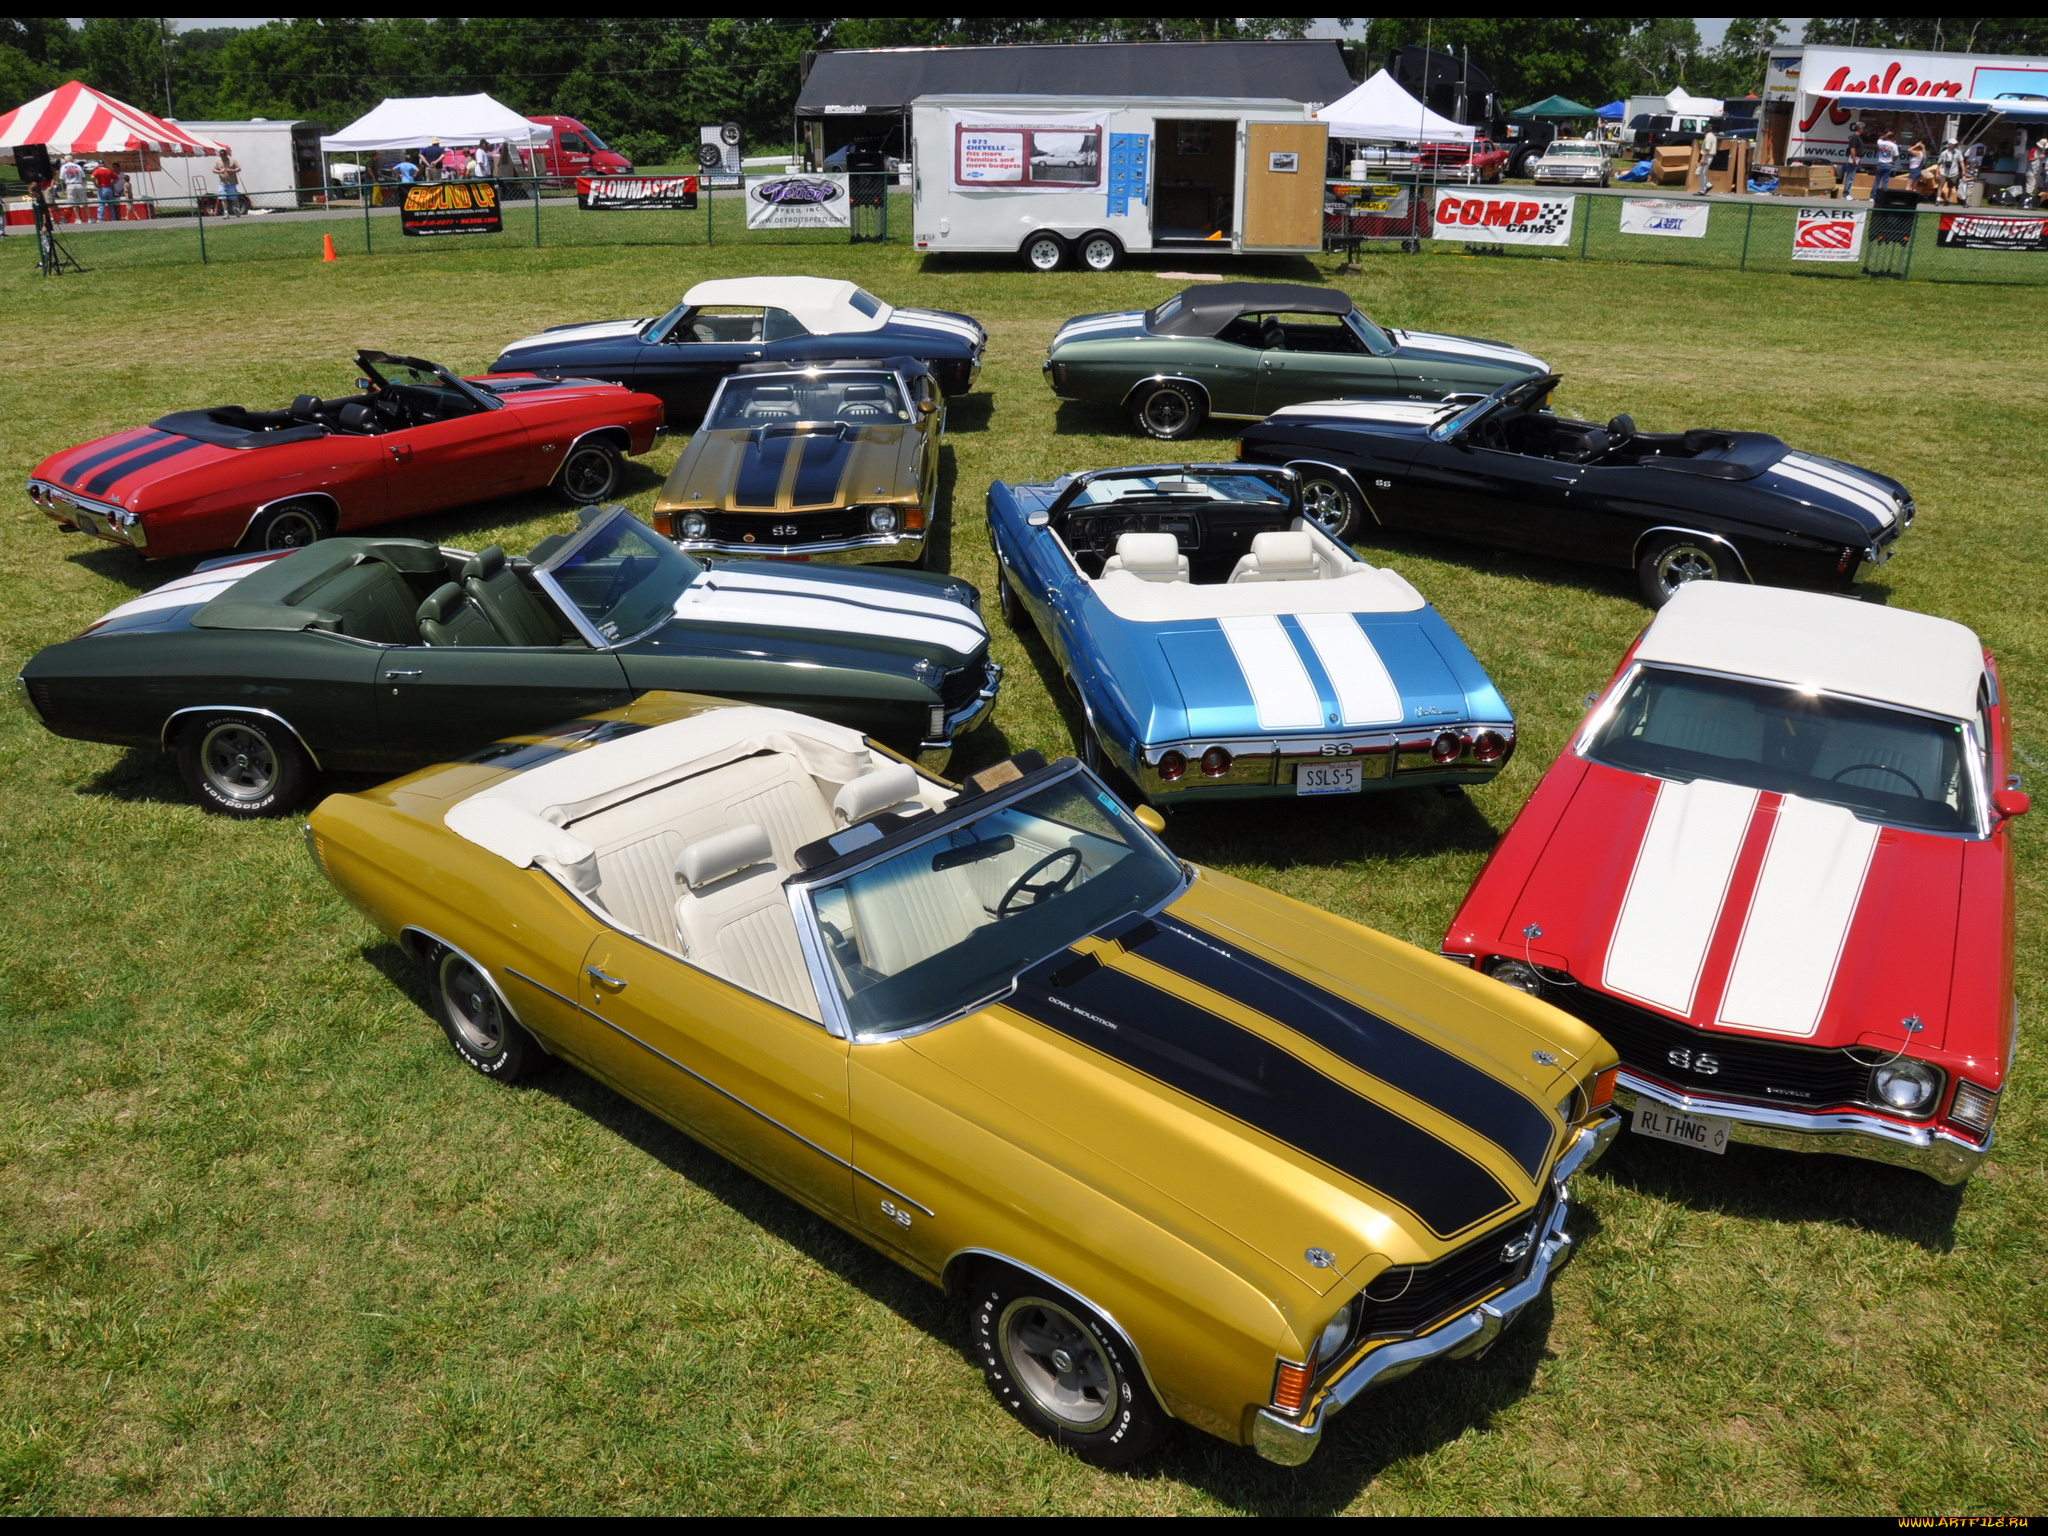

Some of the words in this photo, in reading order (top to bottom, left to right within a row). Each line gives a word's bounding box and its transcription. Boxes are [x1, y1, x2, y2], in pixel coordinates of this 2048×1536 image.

[404, 184, 472, 211] GROUND
[470, 183, 496, 208] UP
[587, 180, 685, 206] FLOWMASTER
[763, 183, 834, 203] Detroit
[1435, 197, 1540, 227] COMP
[1630, 200, 1663, 209] Attention
[1676, 203, 1697, 211] Detail
[1800, 209, 1854, 220] BAER
[751, 216, 847, 225] WWW.DETROITSPEED.COM
[1505, 223, 1558, 235] CAMS
[1945, 217, 2046, 243] FLOWMASTER
[1375, 479, 1391, 488] SS
[772, 525, 798, 536] SS
[206, 717, 247, 729] Radial
[1320, 743, 1354, 757] SS
[202, 782, 276, 811] BFGoodrich
[1048, 996, 1072, 1011] COWL
[1073, 1006, 1118, 1030] INDUCTION
[1666, 1048, 1720, 1075] SS
[881, 1199, 912, 1227] SS
